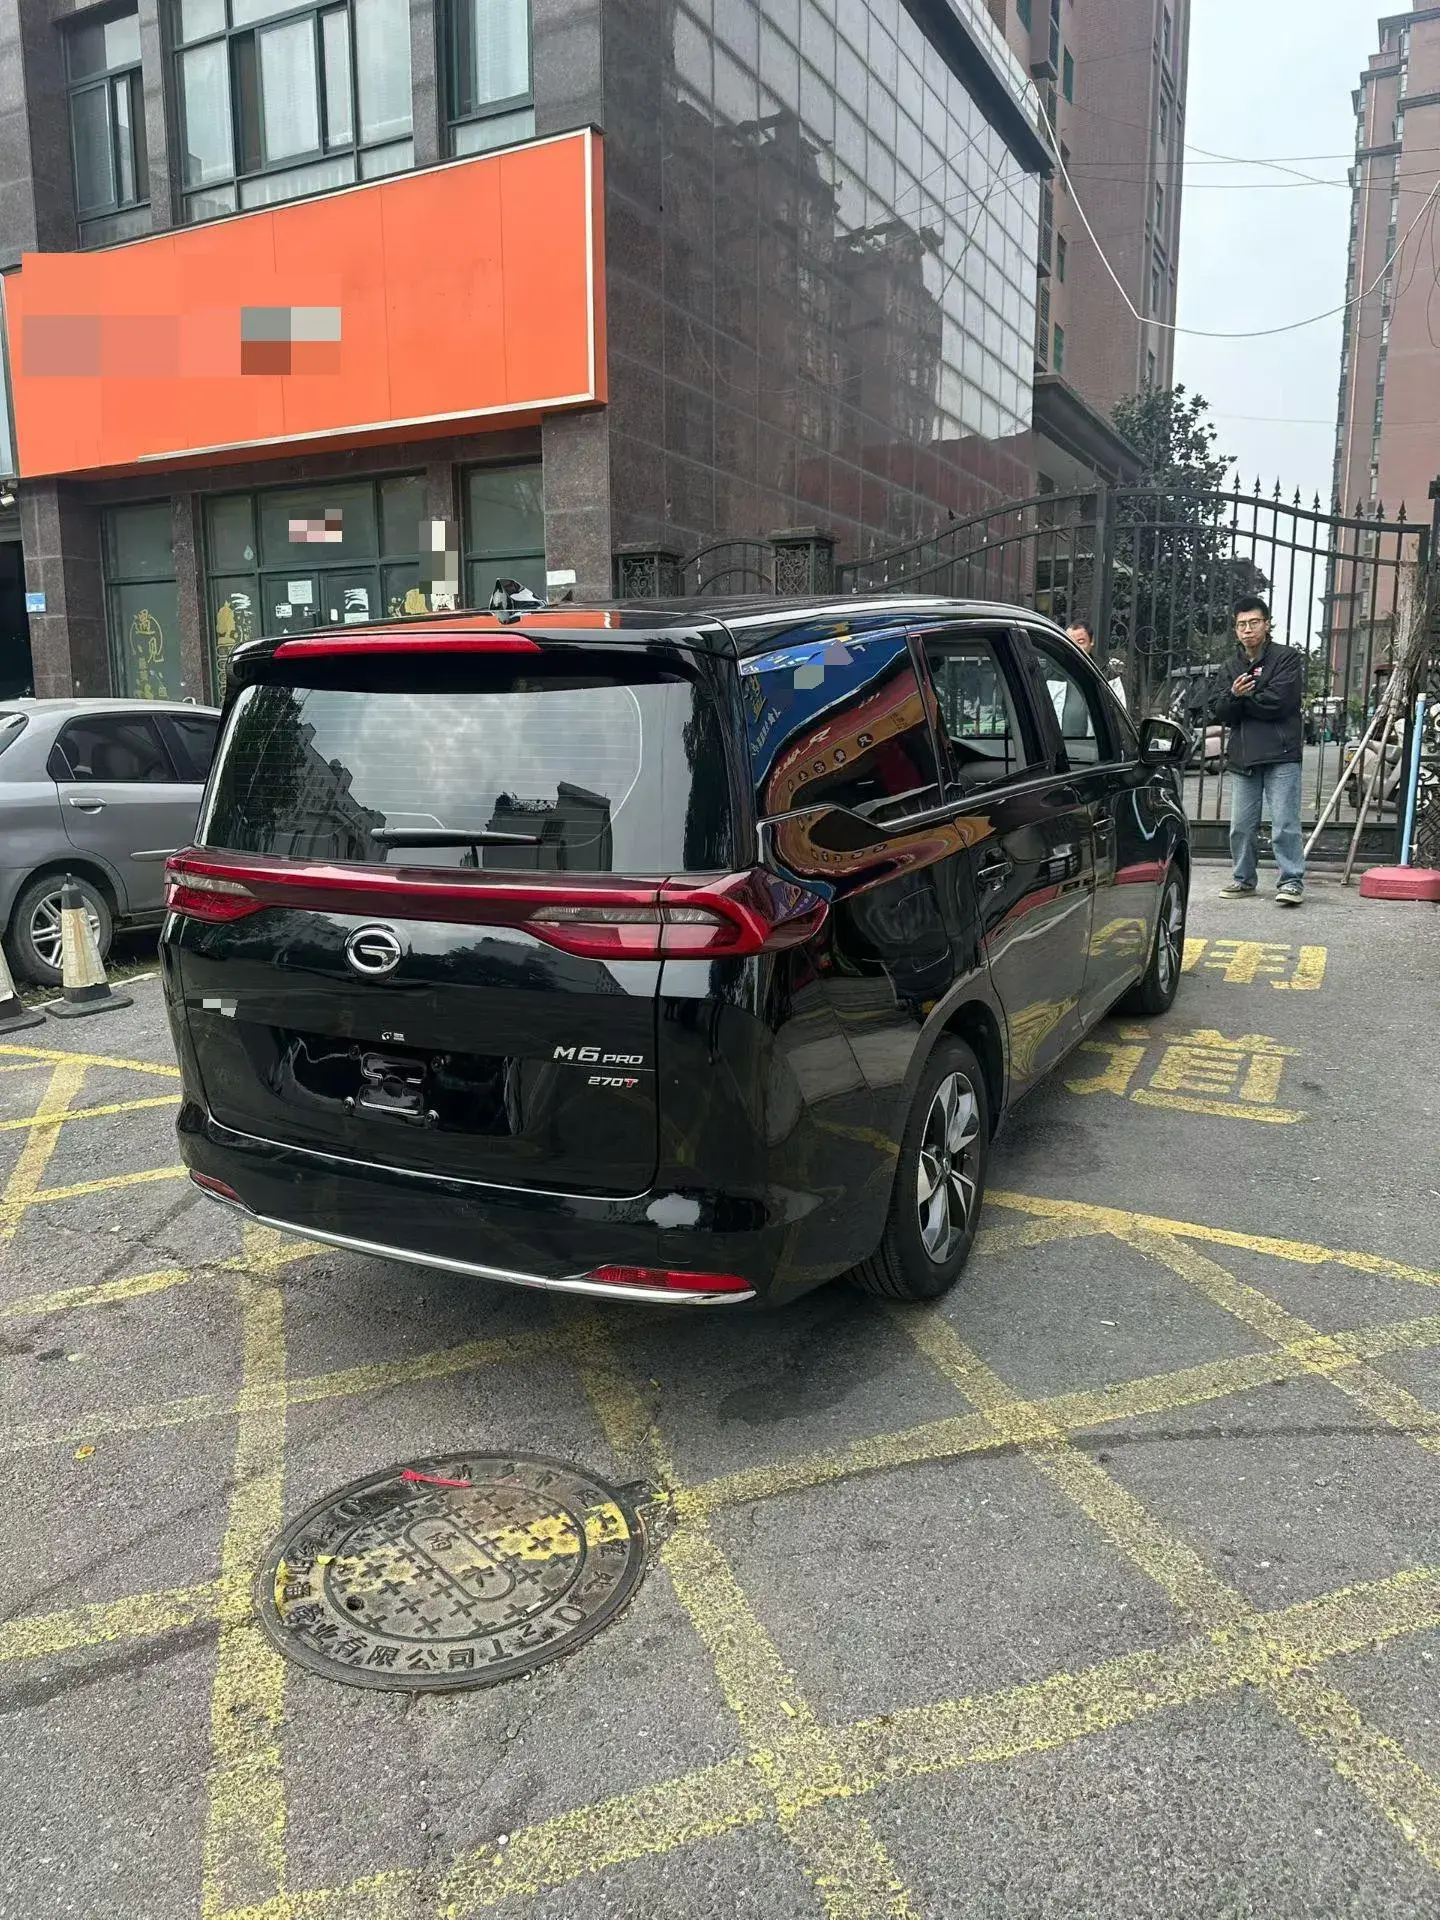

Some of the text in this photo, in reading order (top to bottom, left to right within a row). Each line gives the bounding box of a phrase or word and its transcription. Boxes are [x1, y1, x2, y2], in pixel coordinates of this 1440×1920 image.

[553, 1046, 644, 1065] M6 PRO
[588, 1076, 639, 1088] 270T
